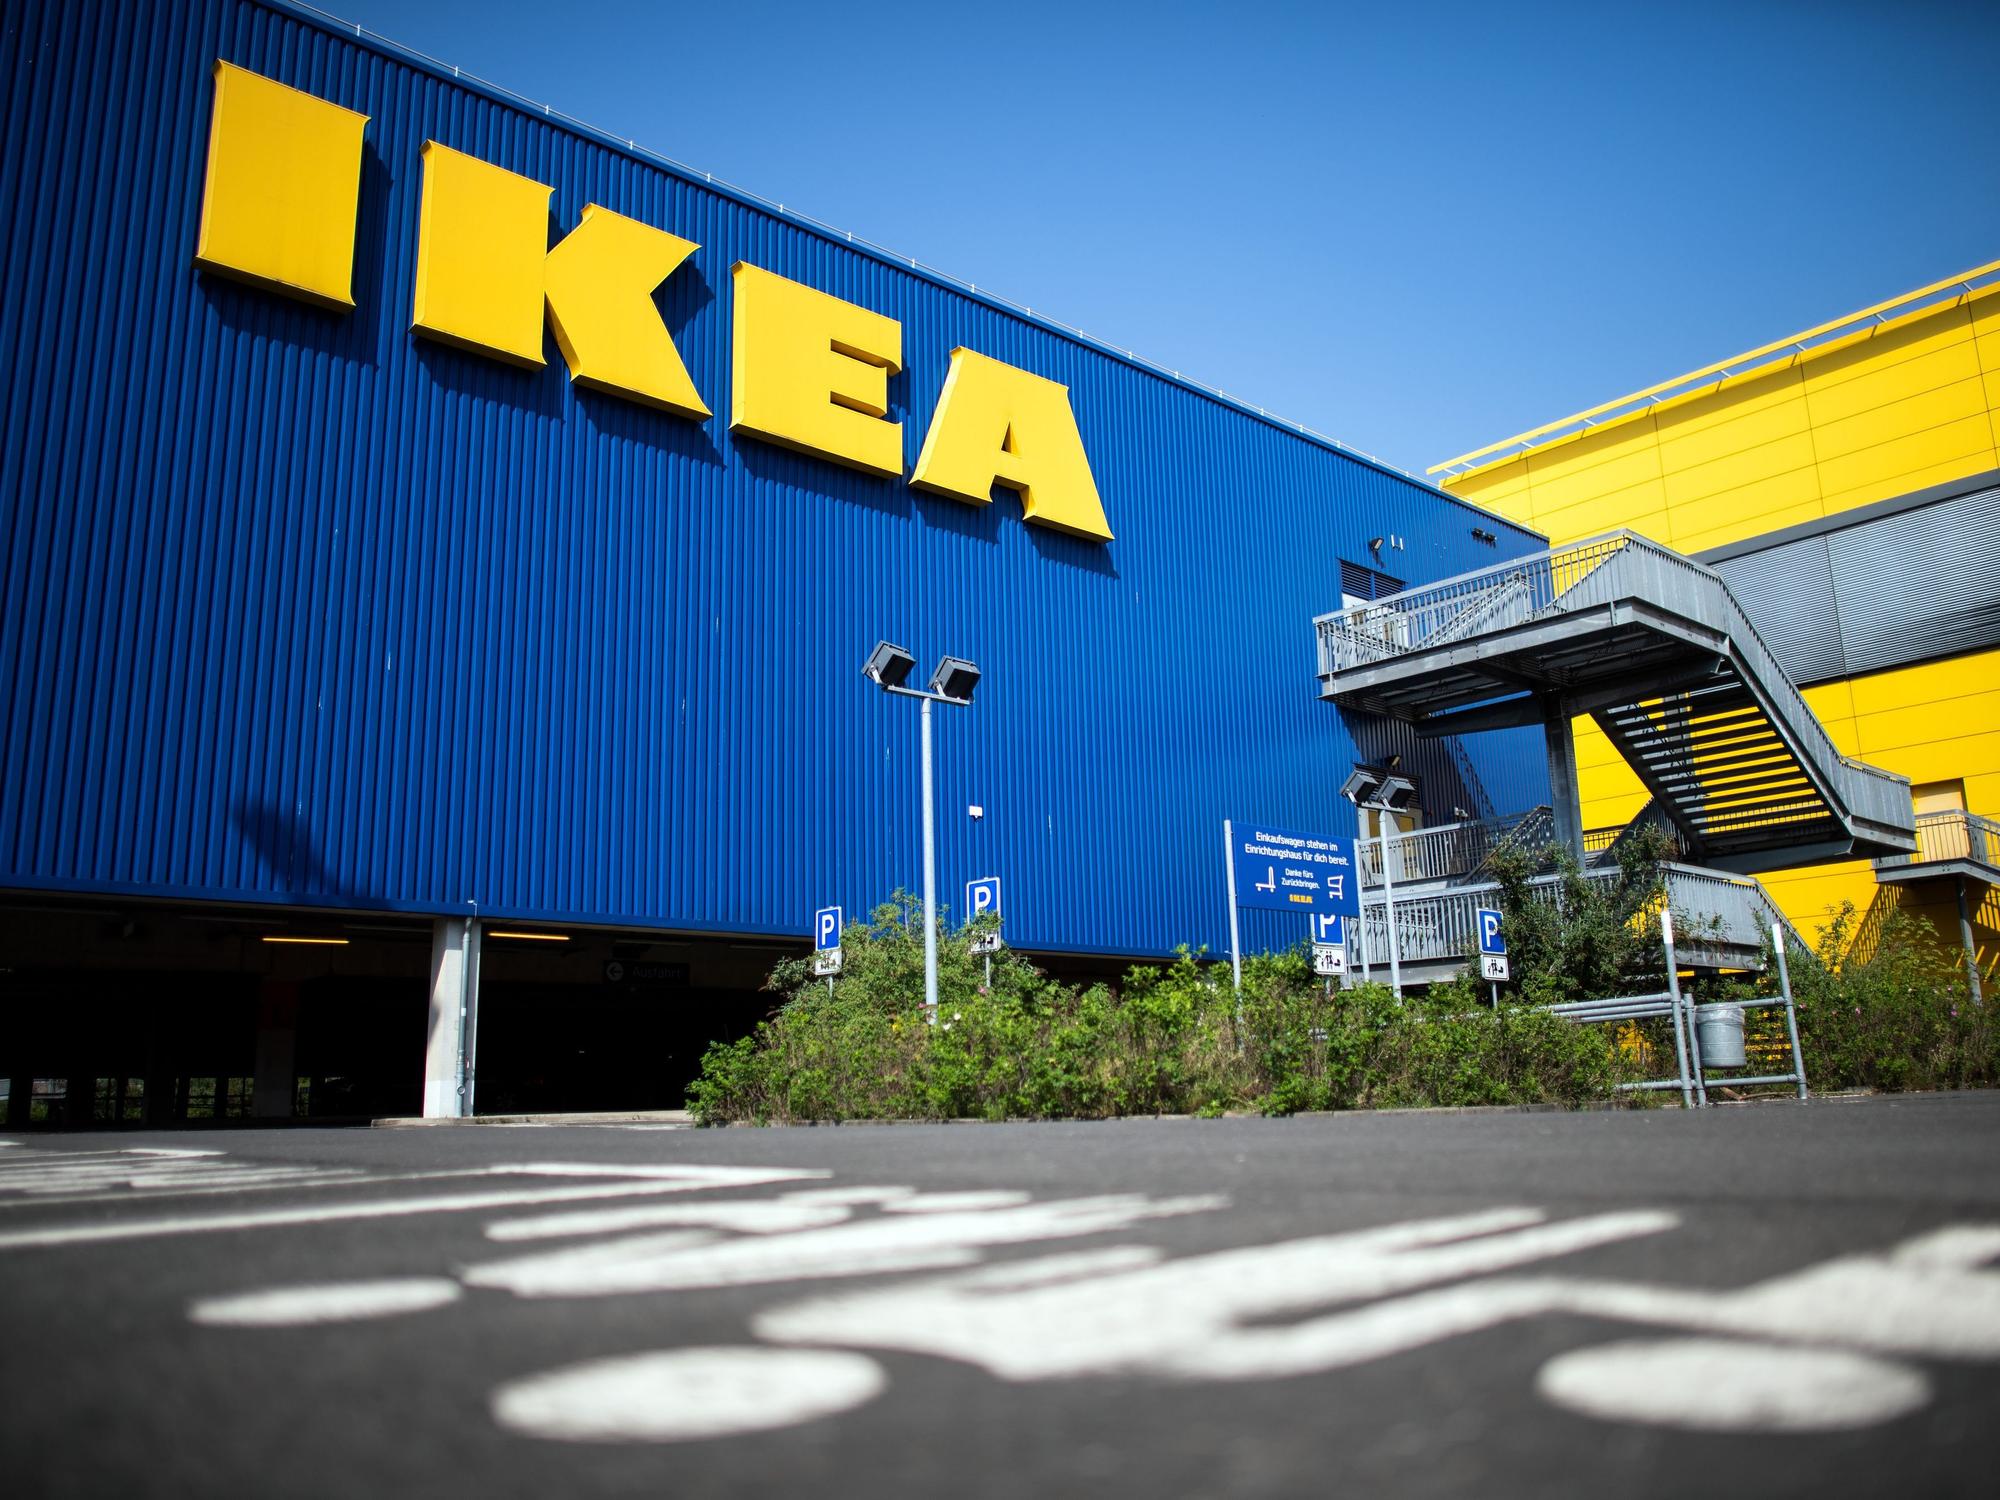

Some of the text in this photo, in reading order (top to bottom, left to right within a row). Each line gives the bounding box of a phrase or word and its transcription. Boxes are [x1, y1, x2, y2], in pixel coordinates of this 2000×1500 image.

[193, 58, 1115, 543] IKEA
[1255, 831, 1338, 852] Einkaufswagen stehen im
[1245, 843, 1349, 866] Einrichtungshaus für dich bereit.
[1281, 877, 1320, 890] Zurückbringen.
[1285, 868, 1302, 878] Danke
[974, 886, 992, 915] P
[821, 914, 835, 946] P
[1319, 914, 1336, 938] P
[1484, 915, 1498, 947] P
